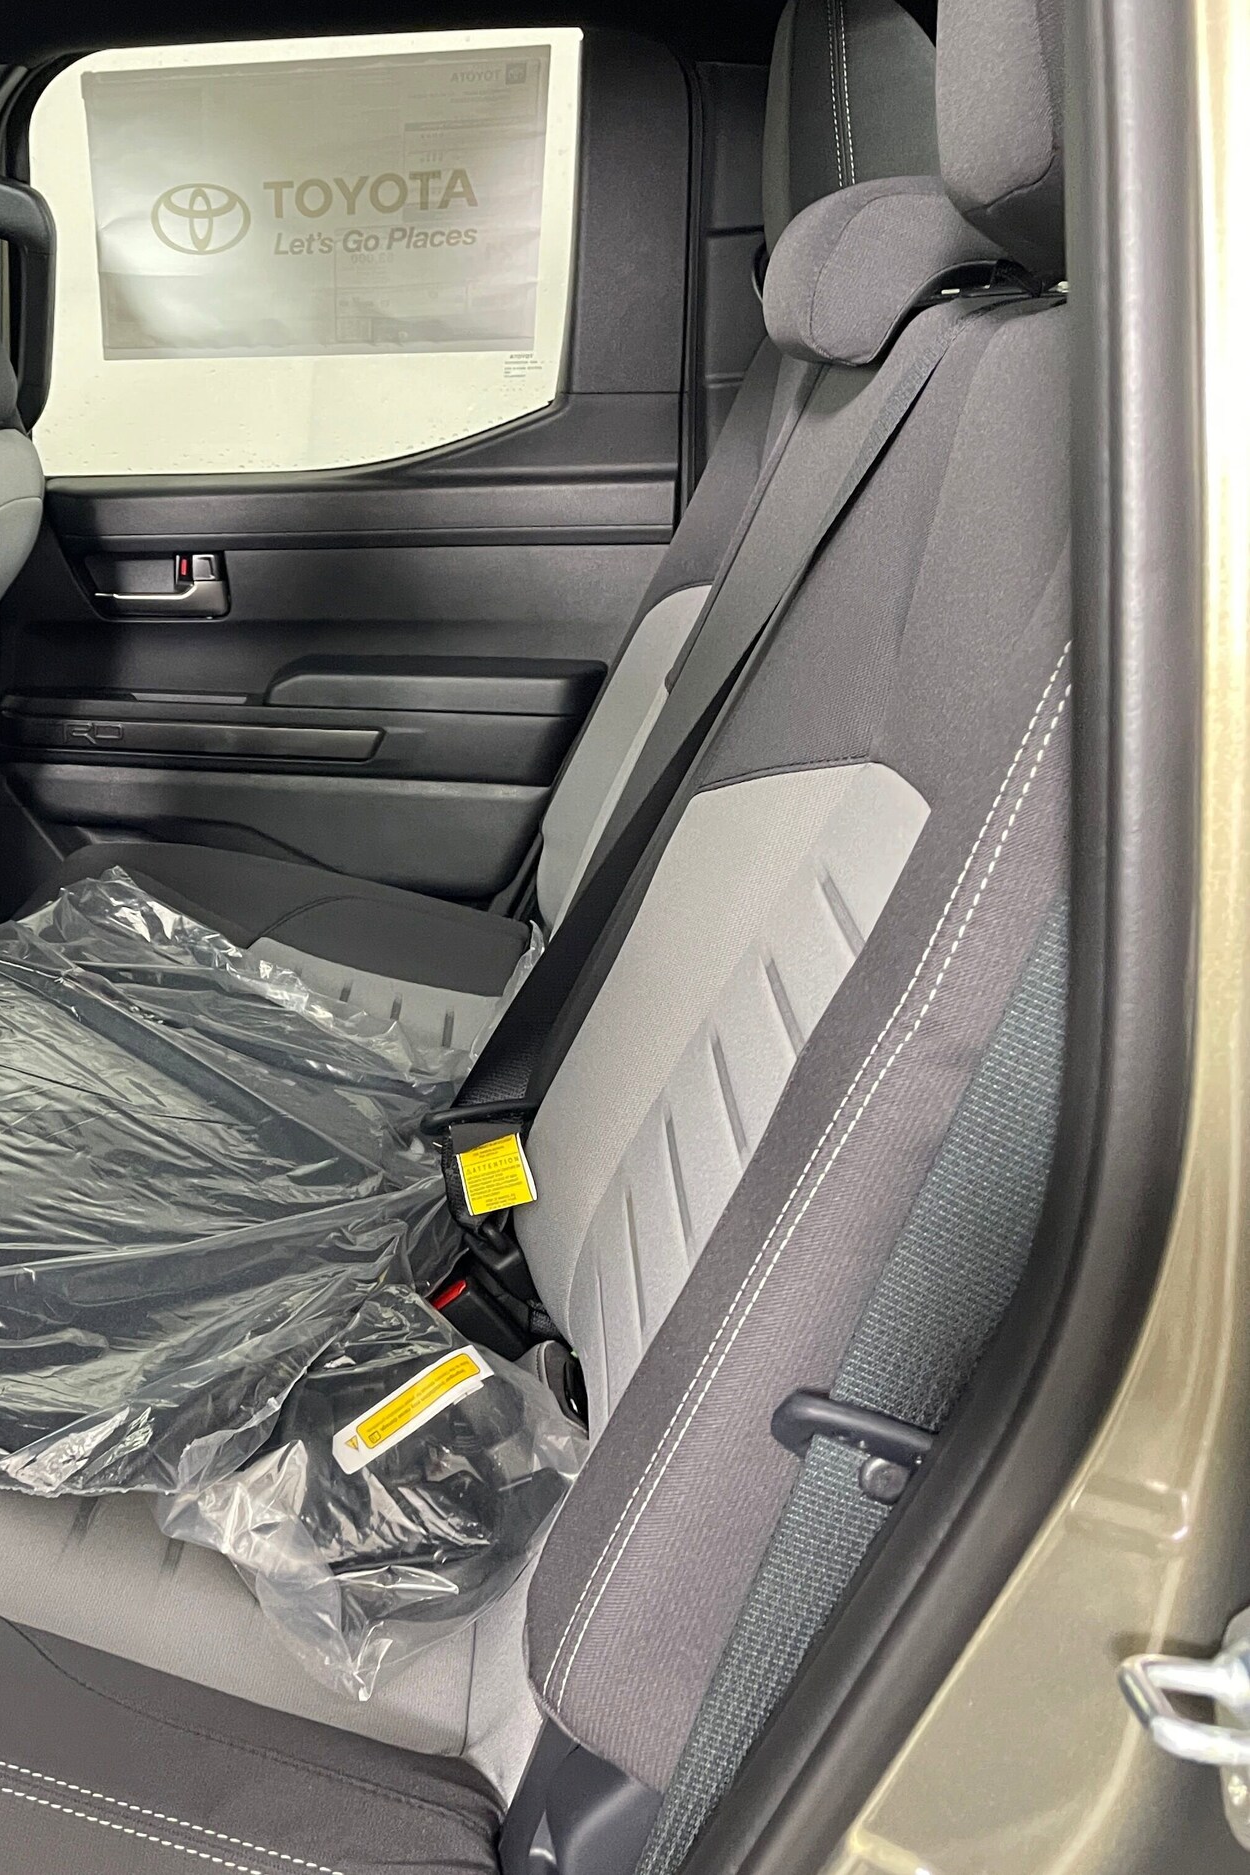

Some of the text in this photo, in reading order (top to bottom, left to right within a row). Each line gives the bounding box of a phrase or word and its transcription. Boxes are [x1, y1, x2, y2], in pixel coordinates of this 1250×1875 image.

[263, 168, 478, 219] TOYOTA
[274, 226, 478, 256] Let's Go Places
